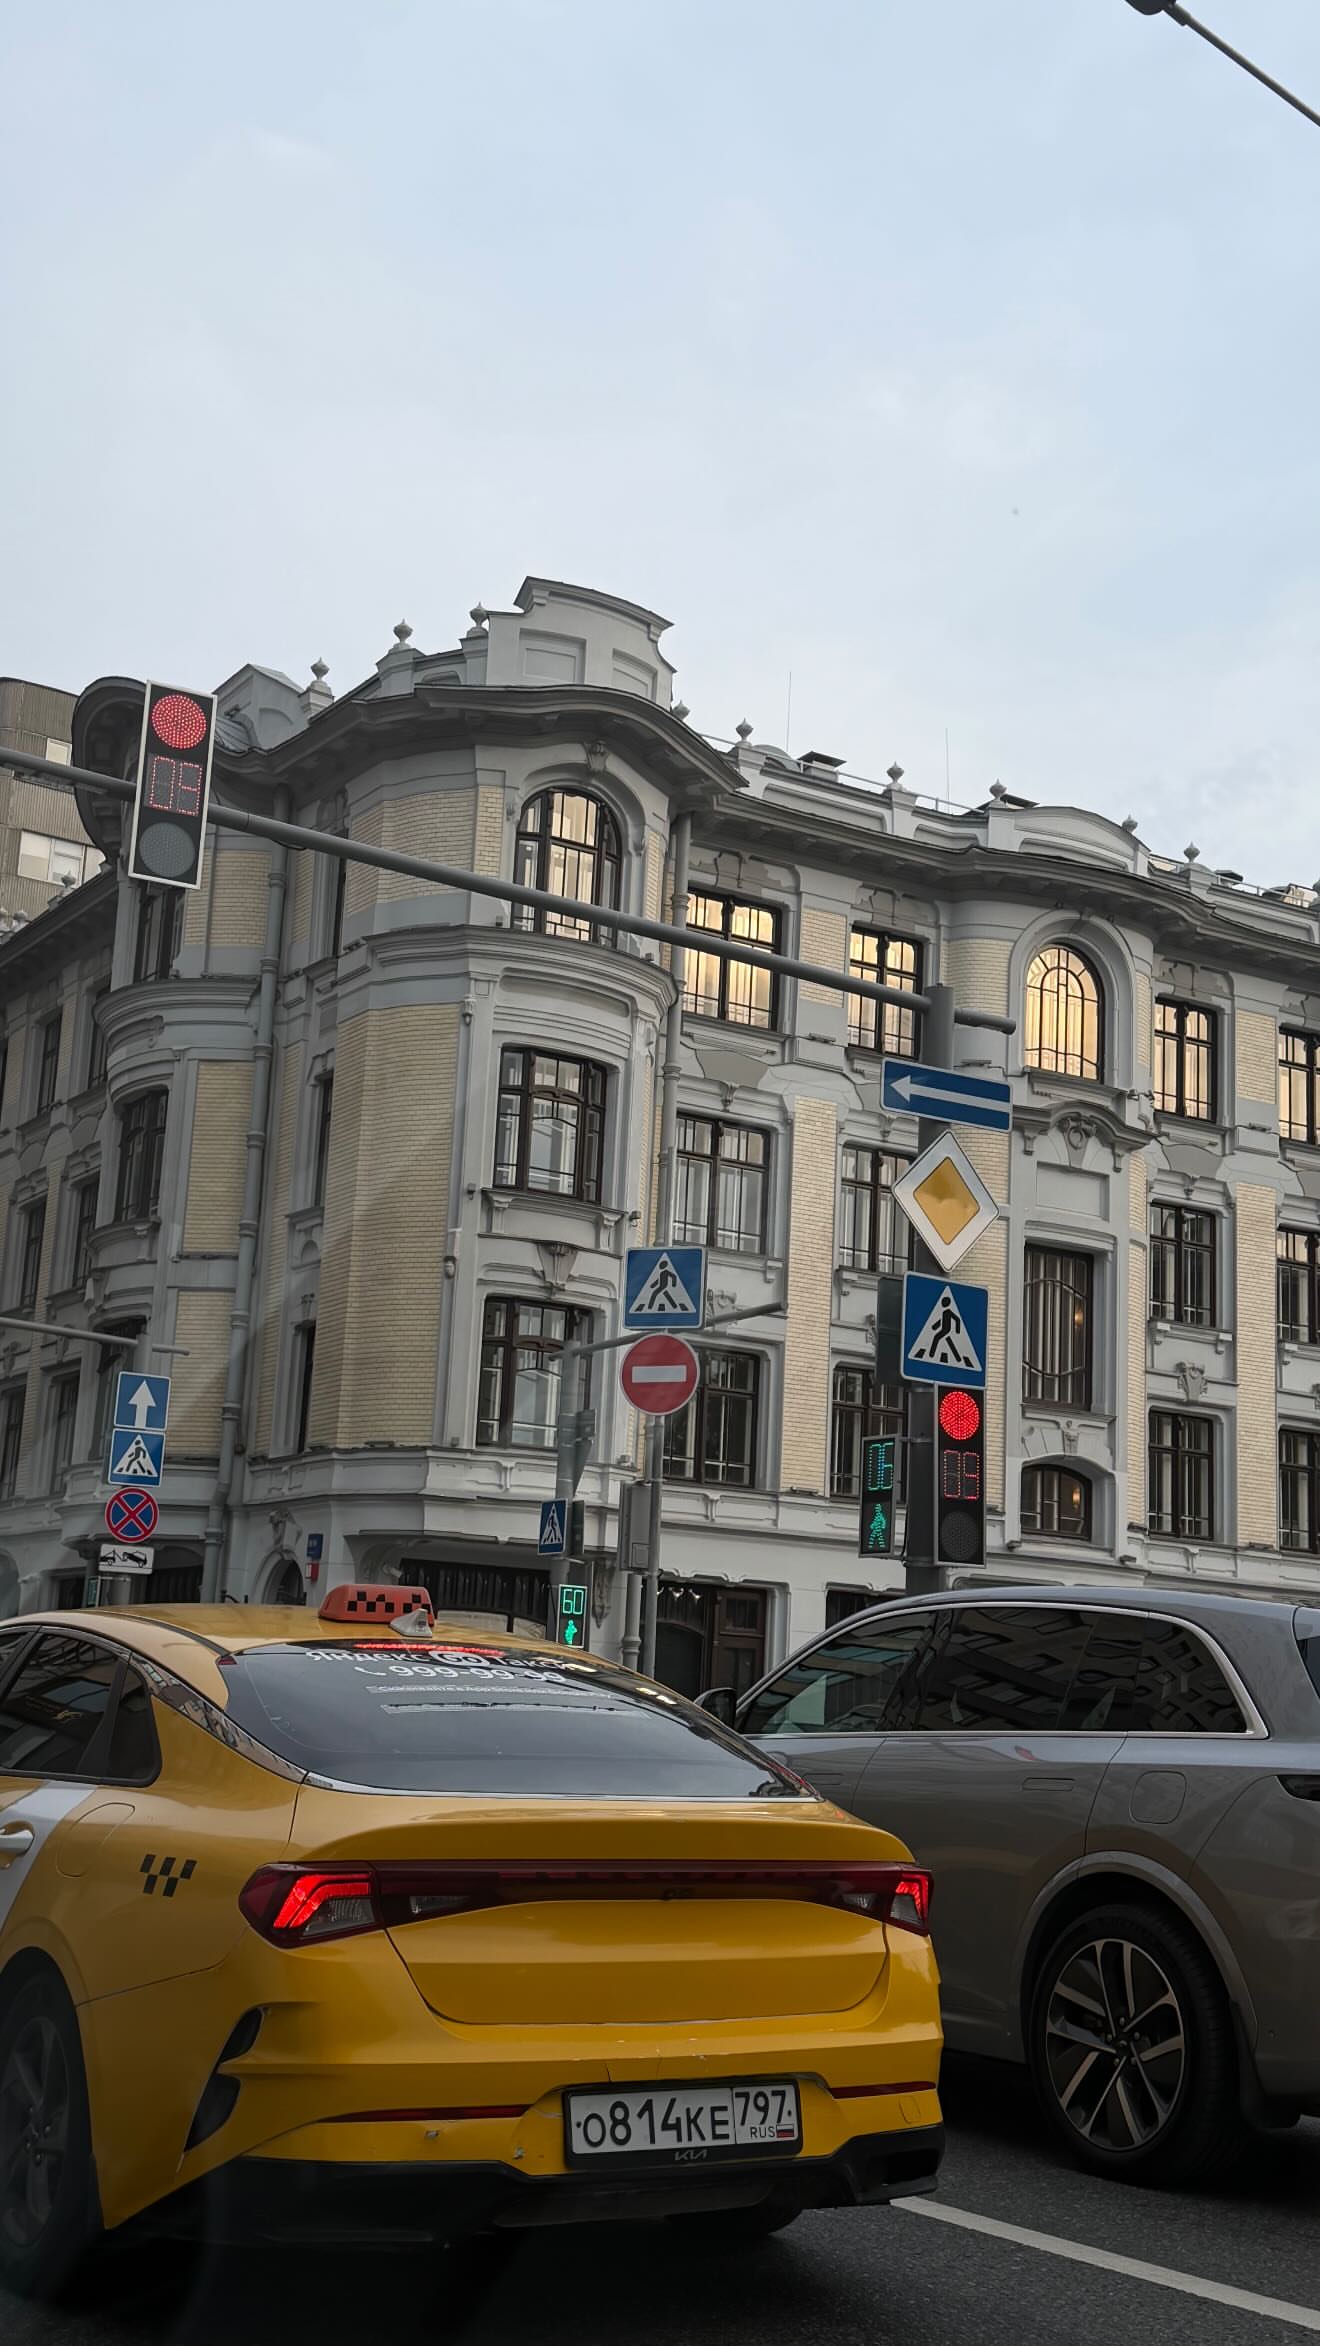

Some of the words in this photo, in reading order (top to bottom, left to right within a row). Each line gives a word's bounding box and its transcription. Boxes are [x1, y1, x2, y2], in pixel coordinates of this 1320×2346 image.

[149, 755, 203, 817] 09
[943, 1449, 980, 1500] 09
[562, 1588, 585, 1615] 60
[305, 1651, 431, 1662] Яндекс
[485, 1655, 577, 1671] Такси
[388, 1665, 567, 1682] 999-99-99
[734, 2090, 786, 2127] 797
[750, 2126, 775, 2139] RUS
